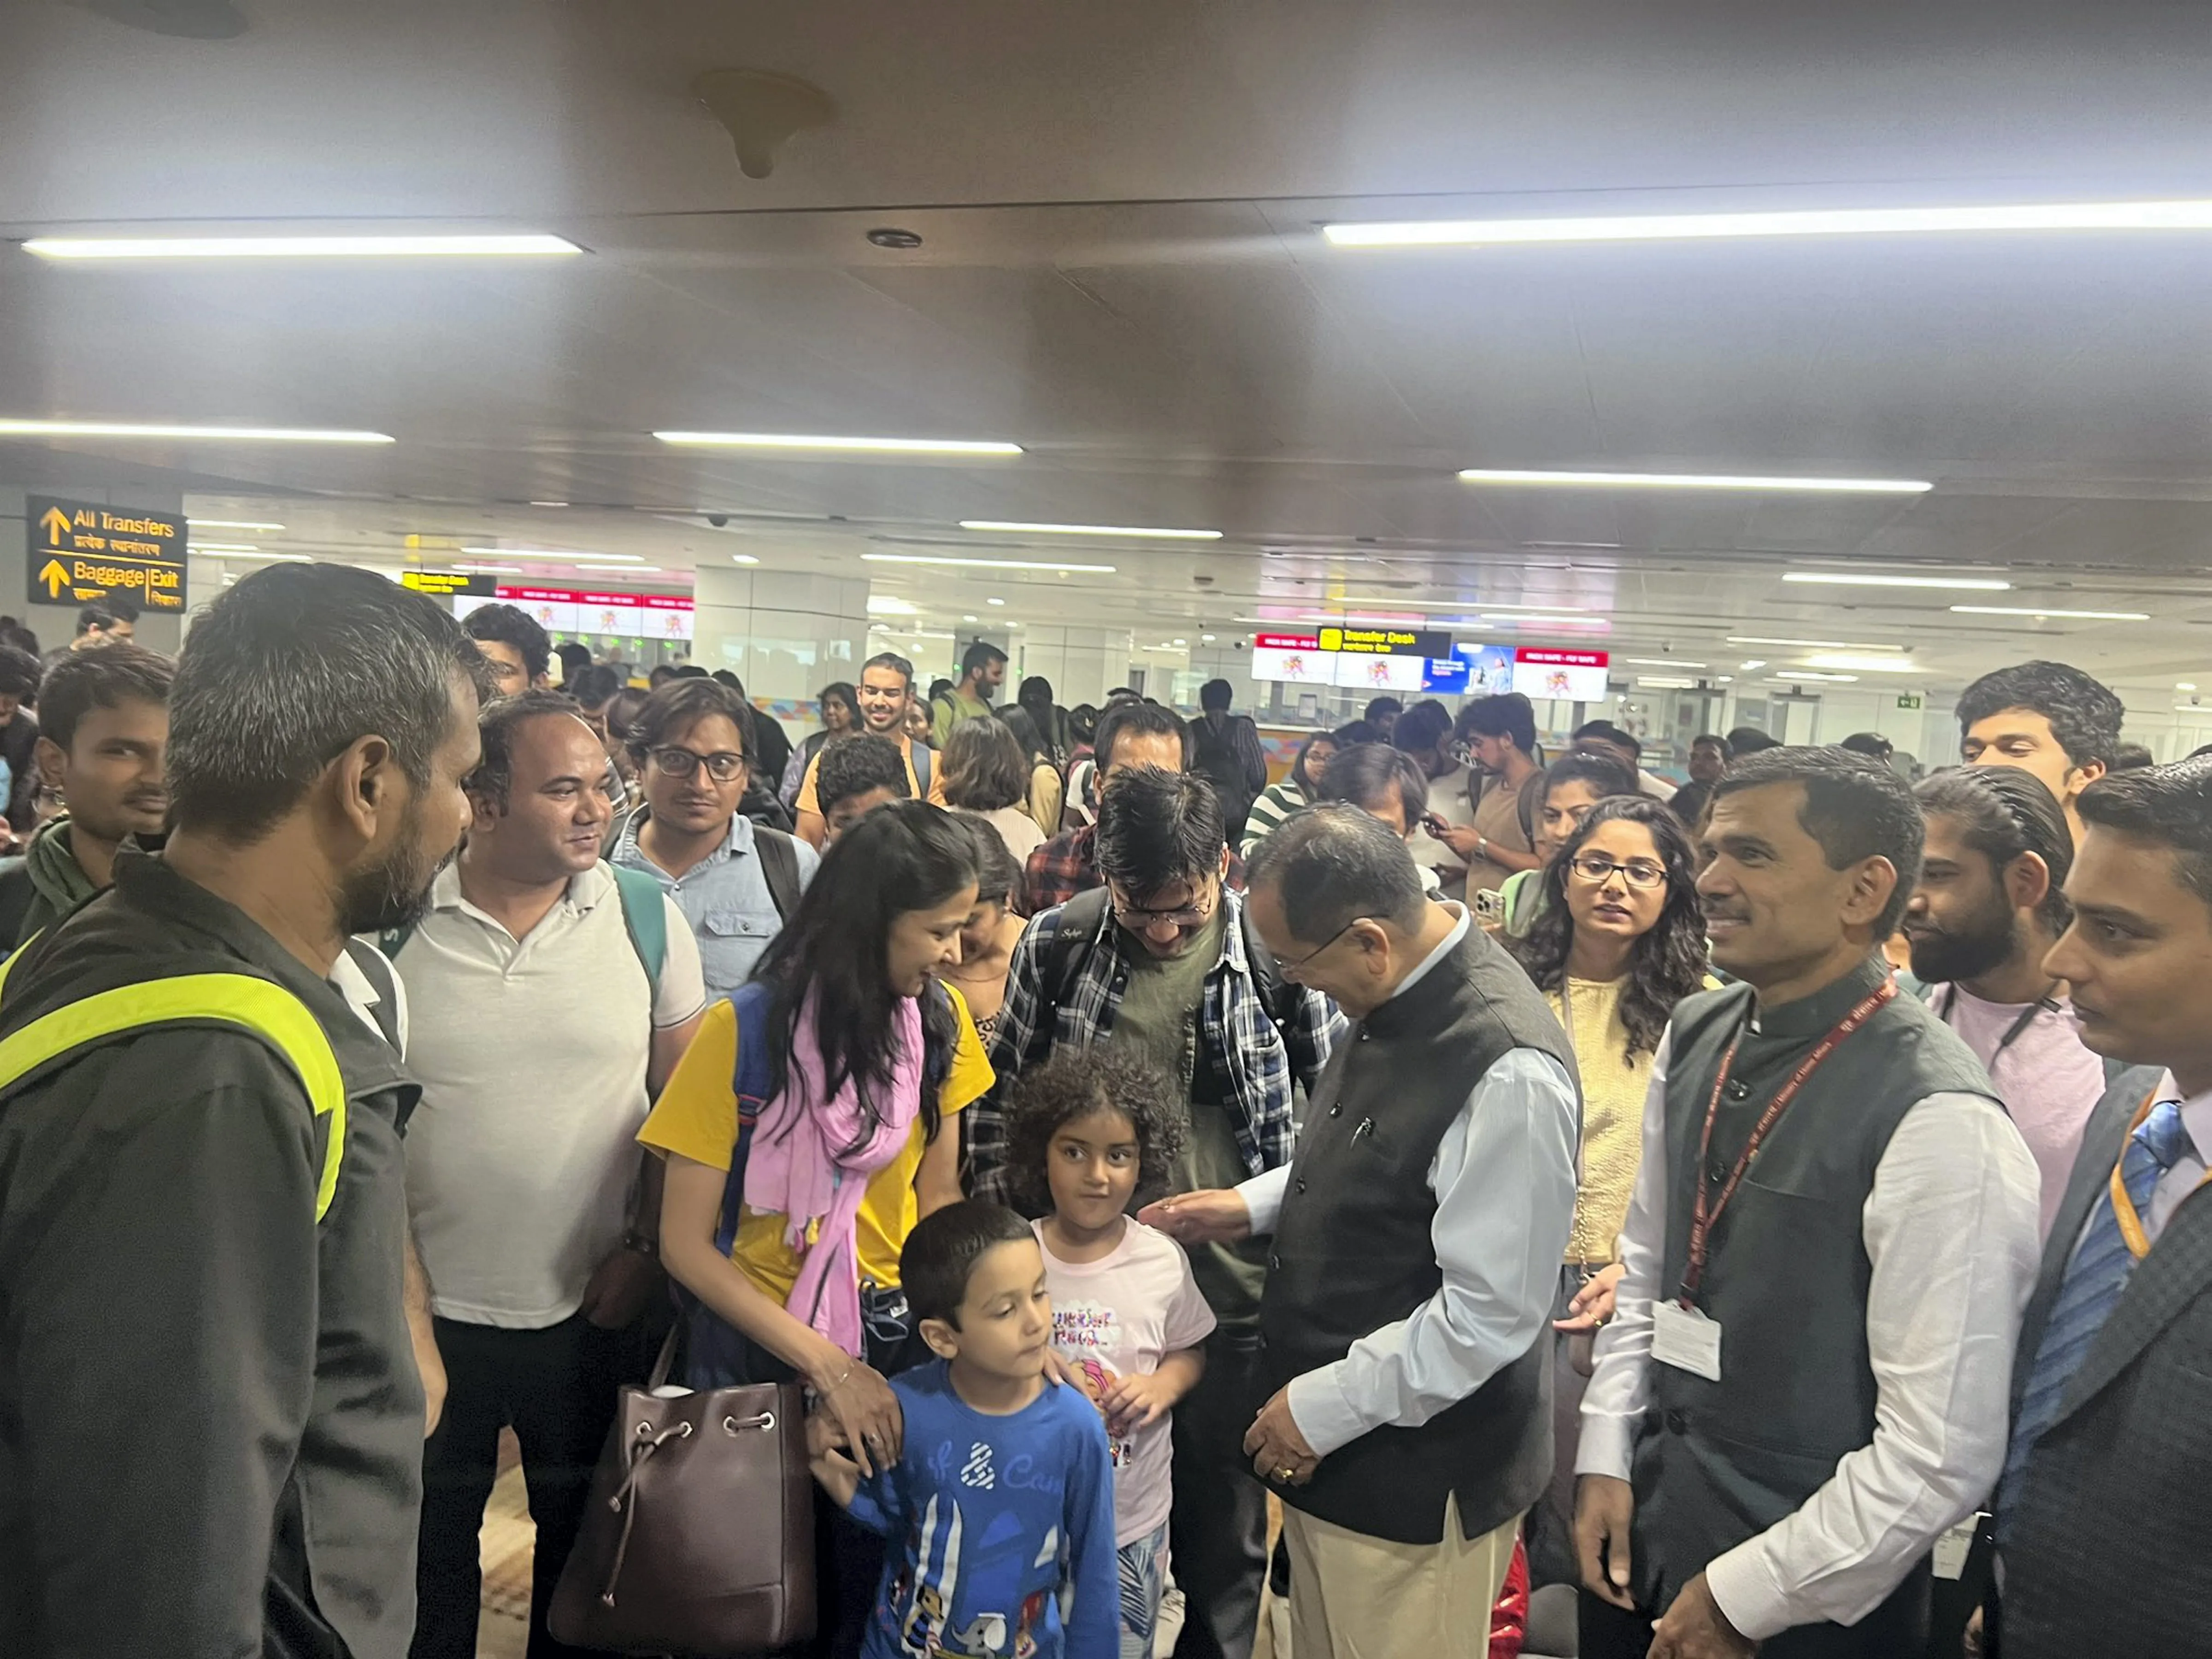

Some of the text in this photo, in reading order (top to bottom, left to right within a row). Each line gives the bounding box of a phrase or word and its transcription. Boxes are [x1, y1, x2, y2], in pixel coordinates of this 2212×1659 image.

[74, 510, 174, 537] All Transfers
[74, 561, 178, 588] Baggage Exit
[1344, 629, 1415, 644] Transfer Desk
